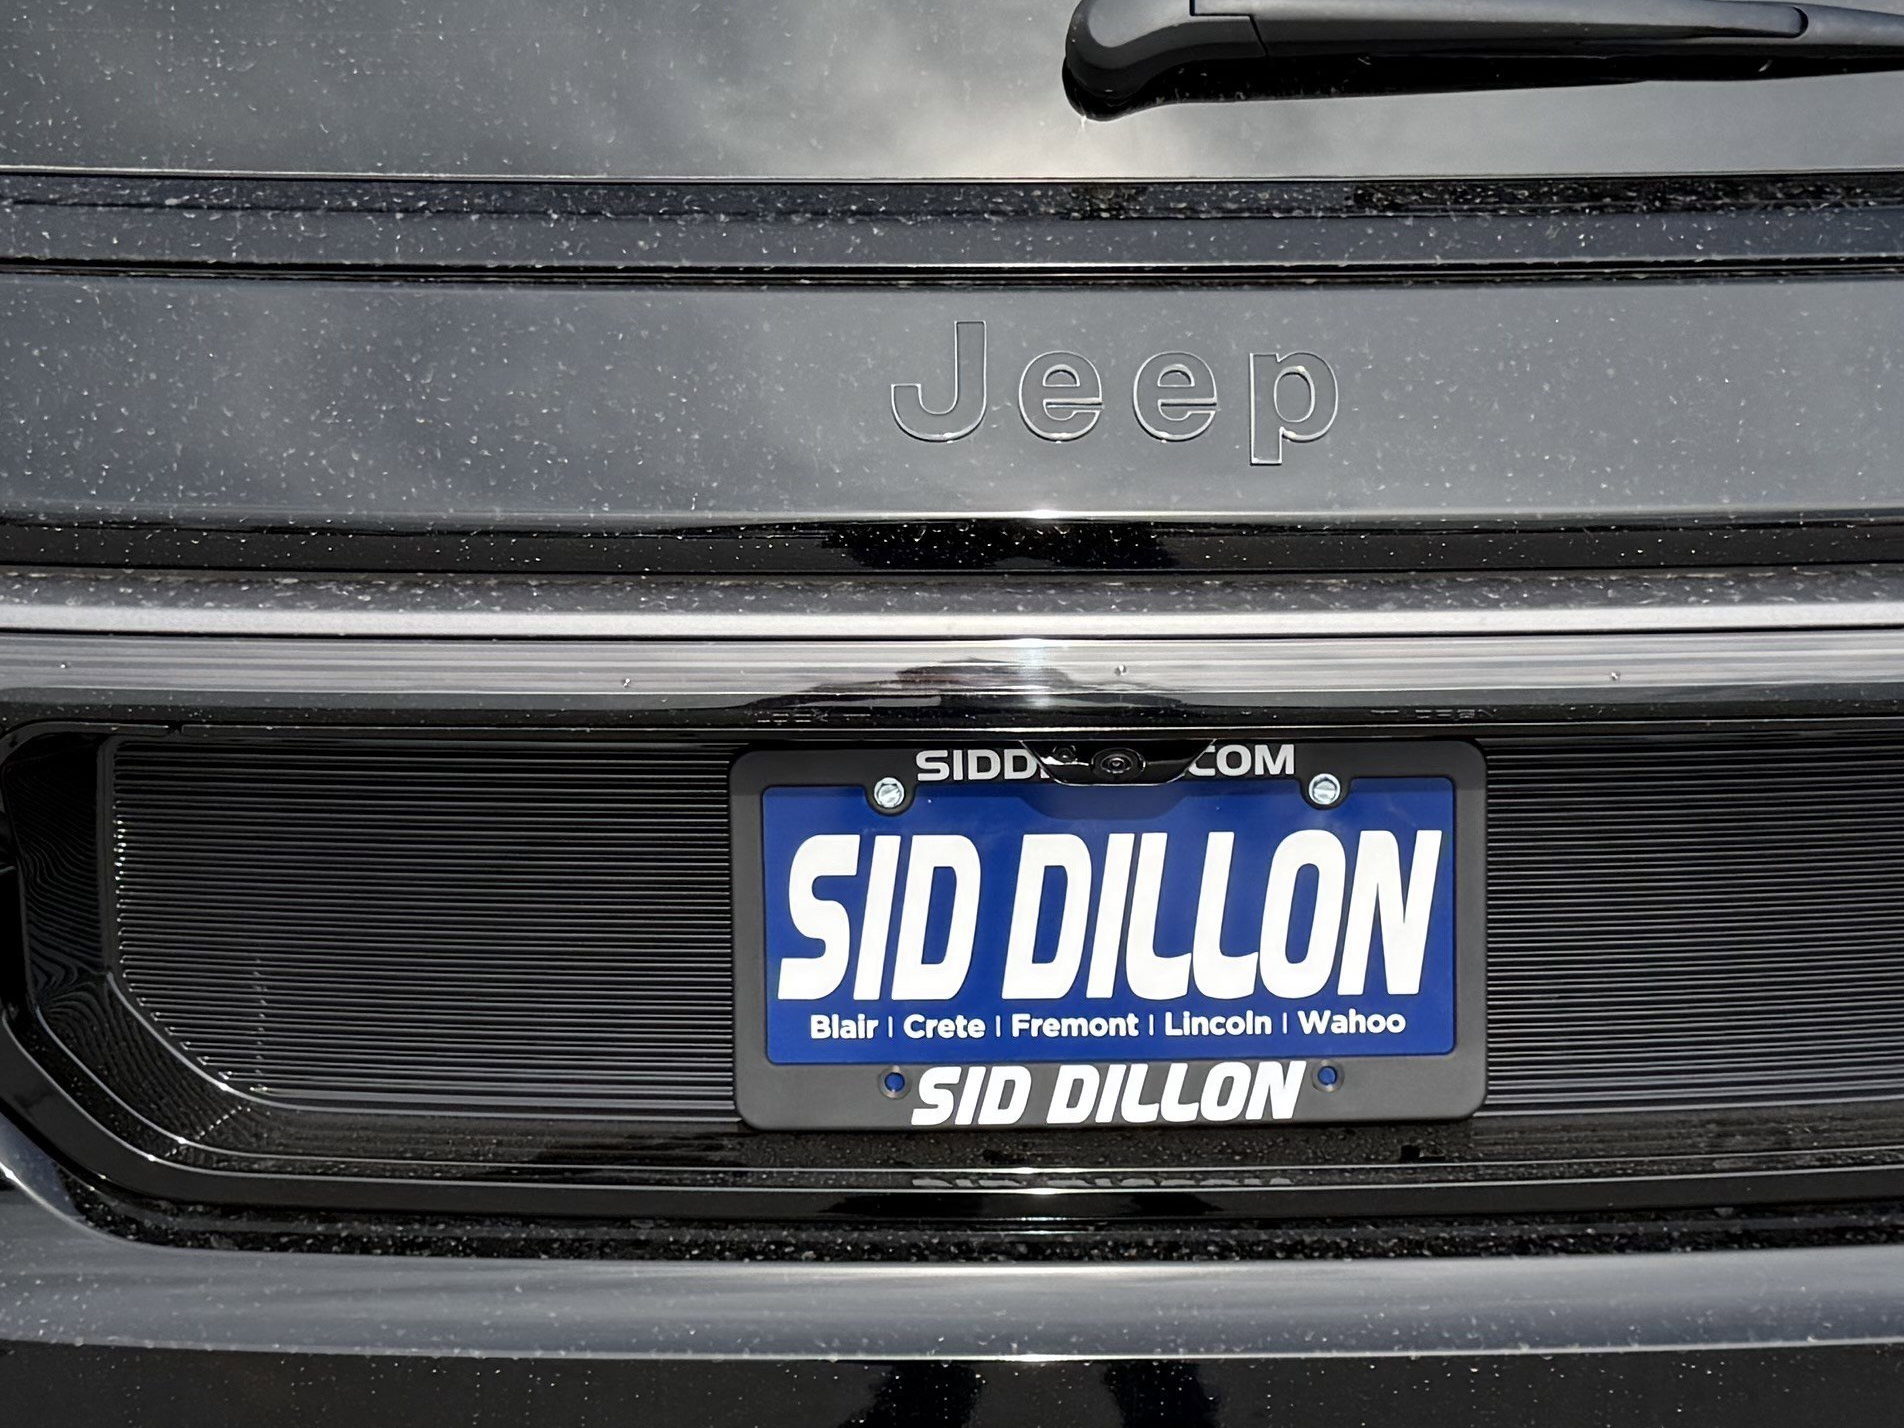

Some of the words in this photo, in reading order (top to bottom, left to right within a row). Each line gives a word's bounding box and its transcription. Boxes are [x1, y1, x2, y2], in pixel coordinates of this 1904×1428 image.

[890, 319, 1339, 465] Jeep
[777, 834, 982, 1002] SID
[1001, 829, 1443, 1001] DILLON
[810, 1013, 879, 1040] Blair
[903, 1013, 986, 1040] Crete
[1011, 1012, 1140, 1039] Fremont
[1164, 1009, 1274, 1037] Lincoln
[1297, 1008, 1408, 1036] Wahoo
[910, 1065, 1032, 1127] SID
[1046, 1060, 1308, 1125] DILLON
